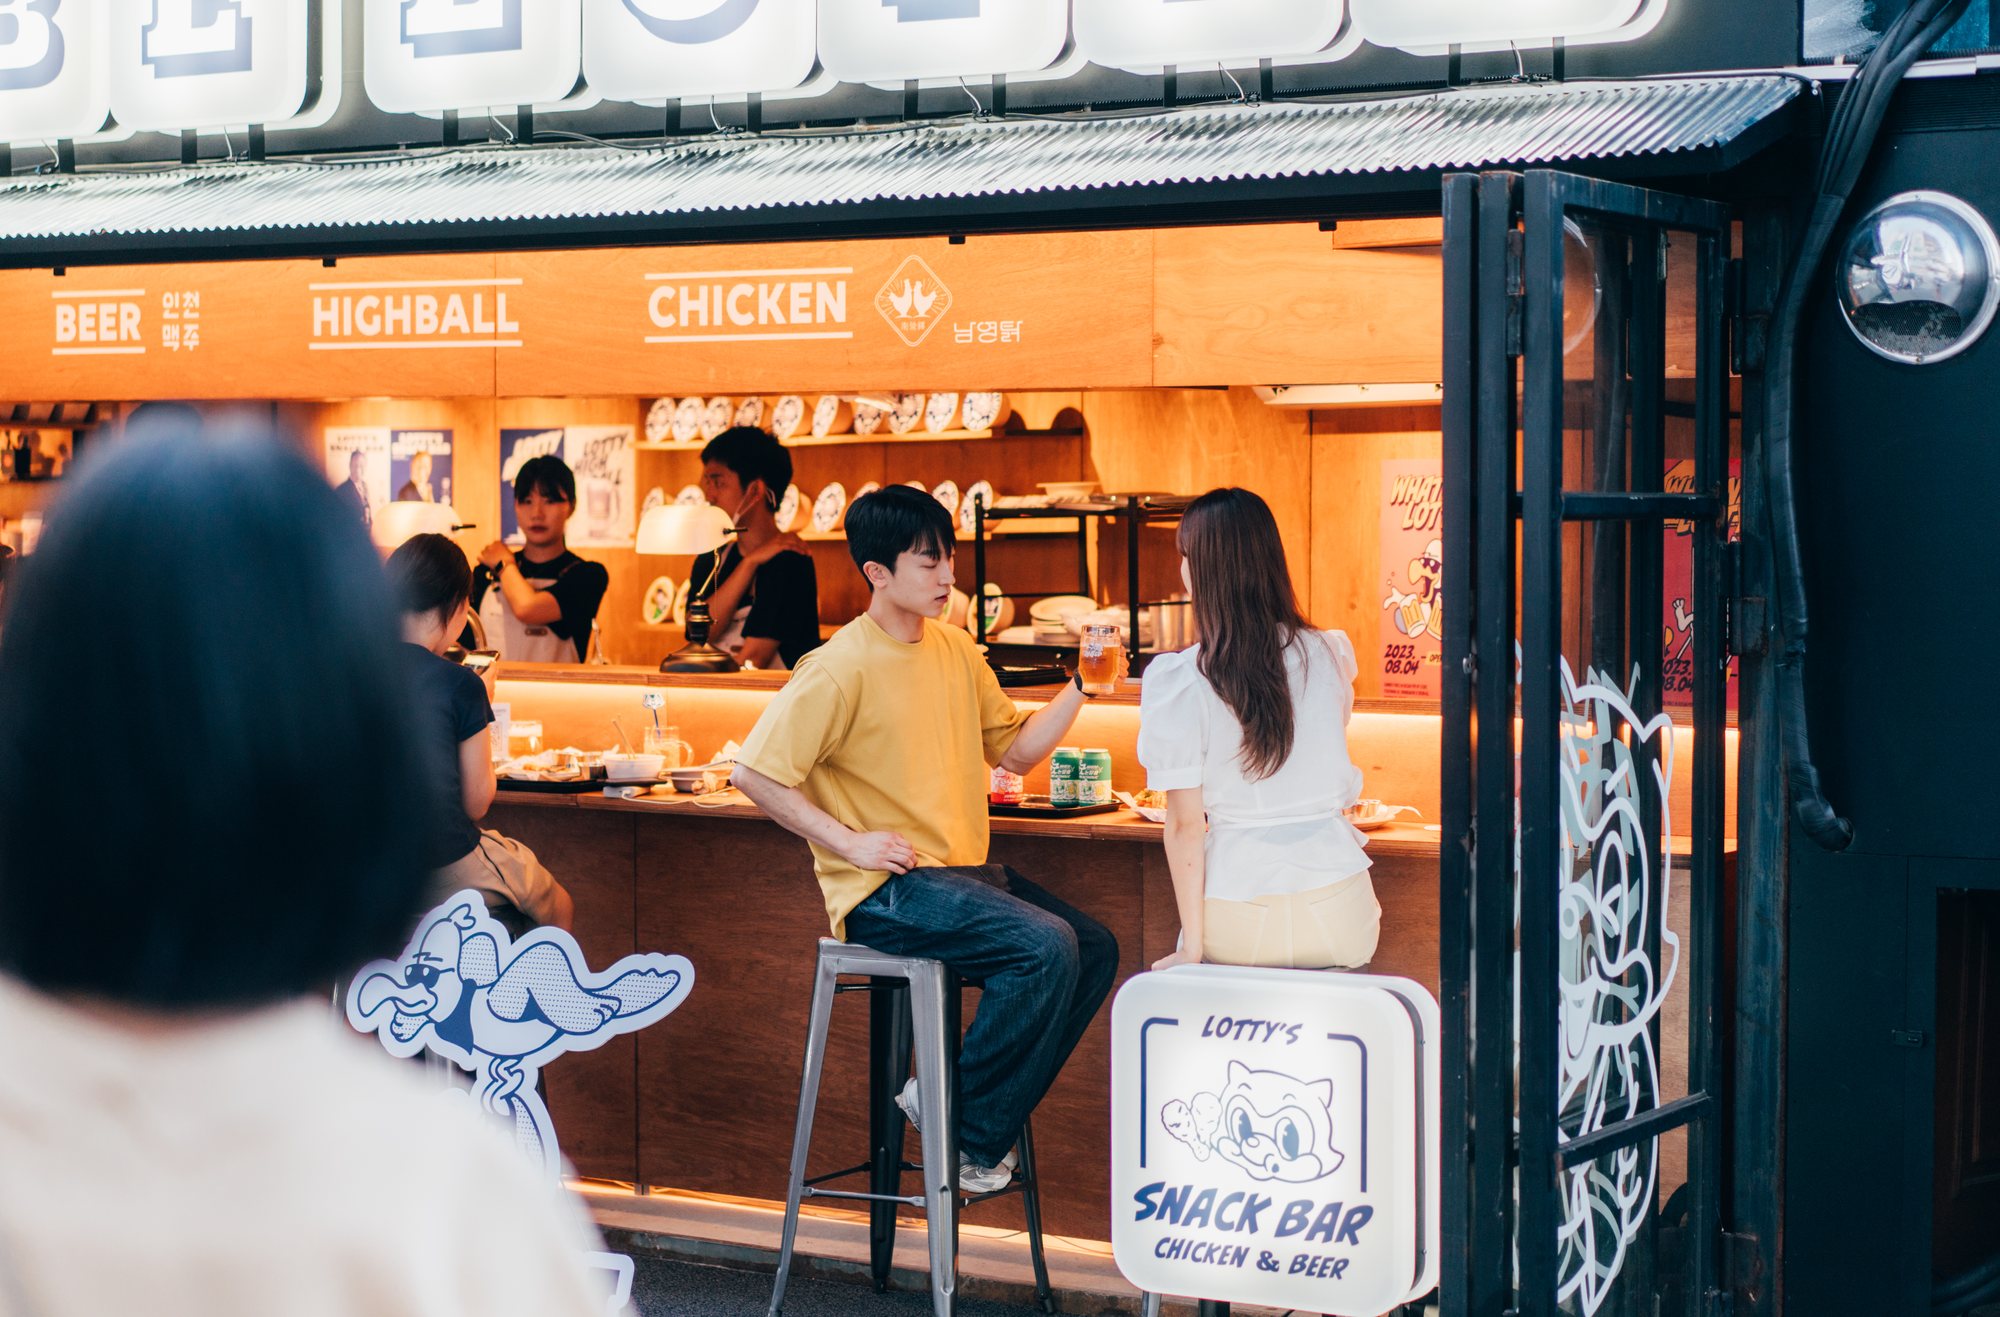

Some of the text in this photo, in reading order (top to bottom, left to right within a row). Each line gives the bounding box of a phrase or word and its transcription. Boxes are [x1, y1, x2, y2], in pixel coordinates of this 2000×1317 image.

[162, 291, 200, 320] 인천
[313, 292, 520, 337] HIGHBALL
[648, 280, 847, 328] CHICKEN
[56, 302, 142, 342] BEER
[953, 320, 1024, 344] 남영탉
[162, 323, 200, 352] 맥주
[1402, 501, 1443, 531] LOT
[1384, 644, 1416, 659] 2023.
[1385, 660, 1420, 675] 08.04
[1664, 659, 1692, 676] 023.
[1201, 1015, 1304, 1045] LOTTY'S
[1133, 1181, 1374, 1246] SNACK BAR
[1154, 1237, 1350, 1280] CHICKEN & BEER
